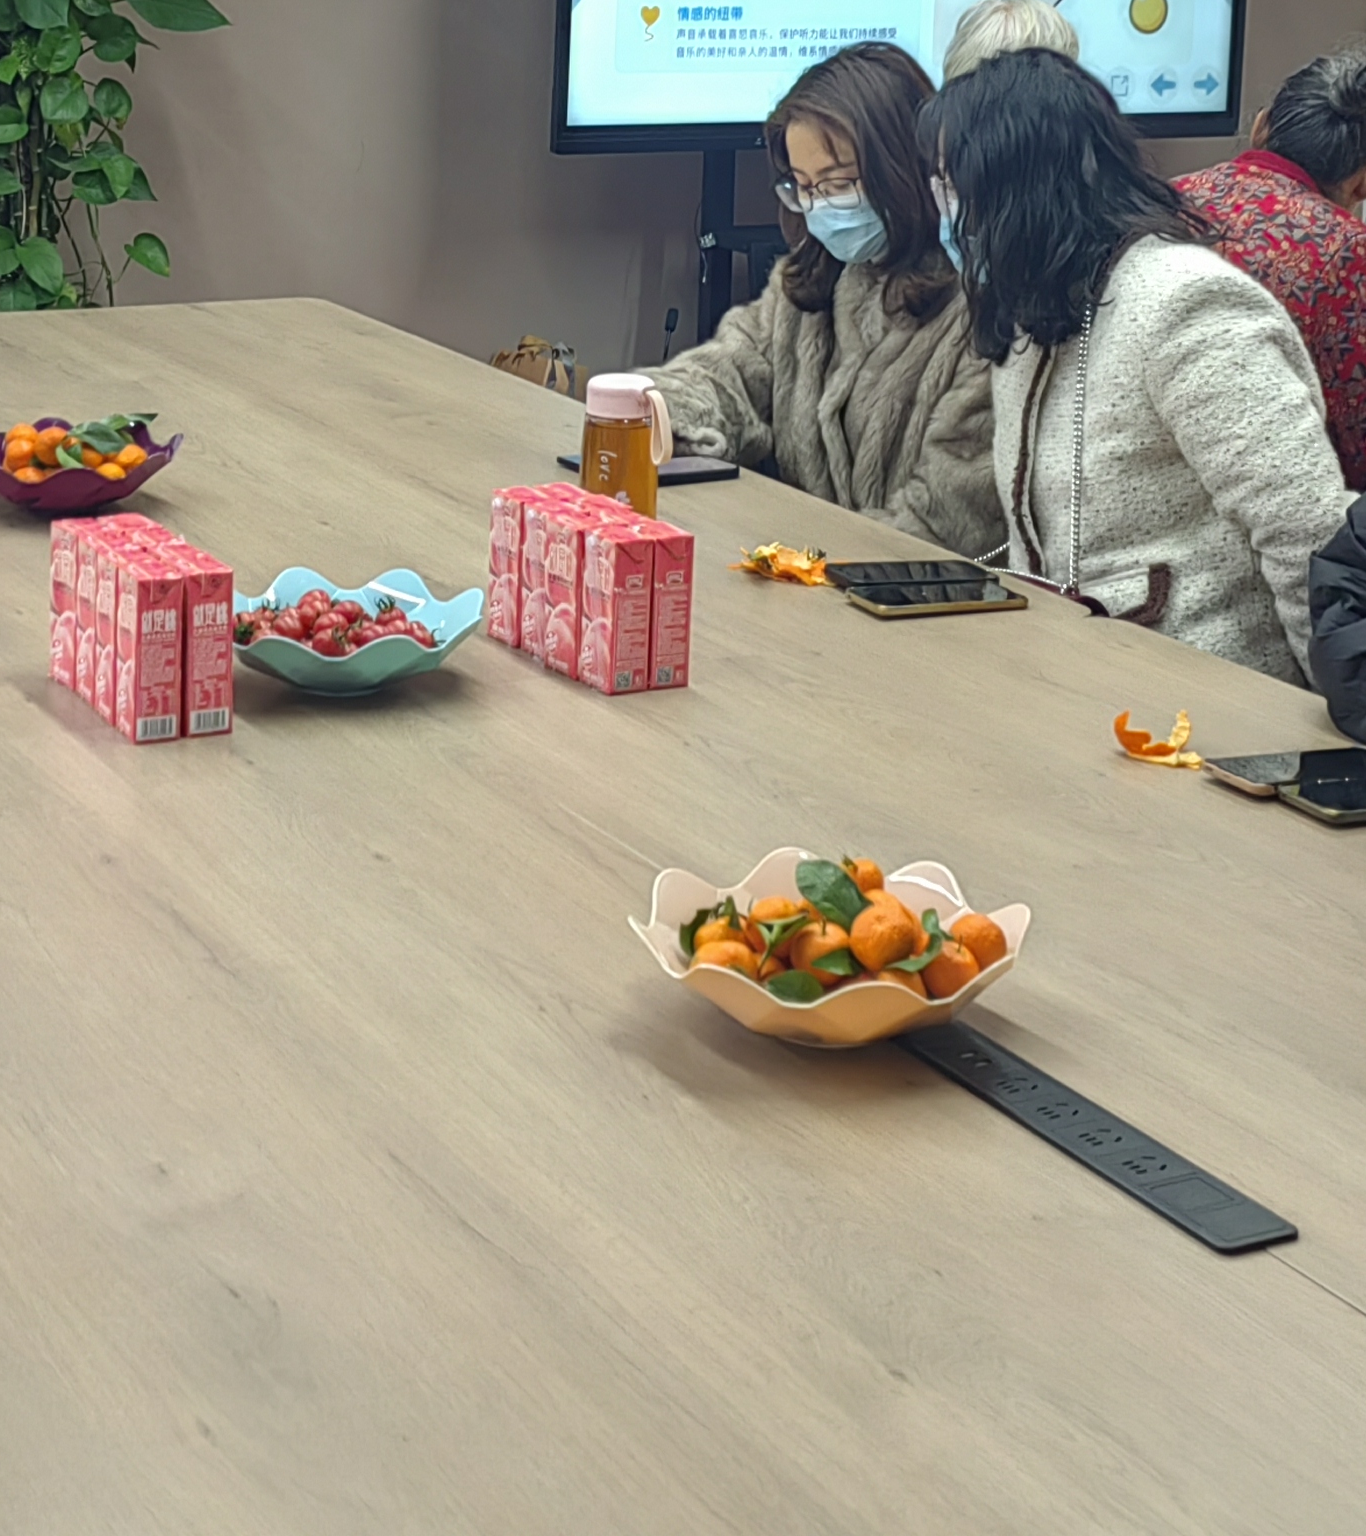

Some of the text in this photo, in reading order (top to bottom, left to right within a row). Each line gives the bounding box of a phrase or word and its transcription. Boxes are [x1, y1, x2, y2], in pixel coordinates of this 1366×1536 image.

[677, 6, 743, 21] 情感的纽带
[598, 450, 617, 482] love
